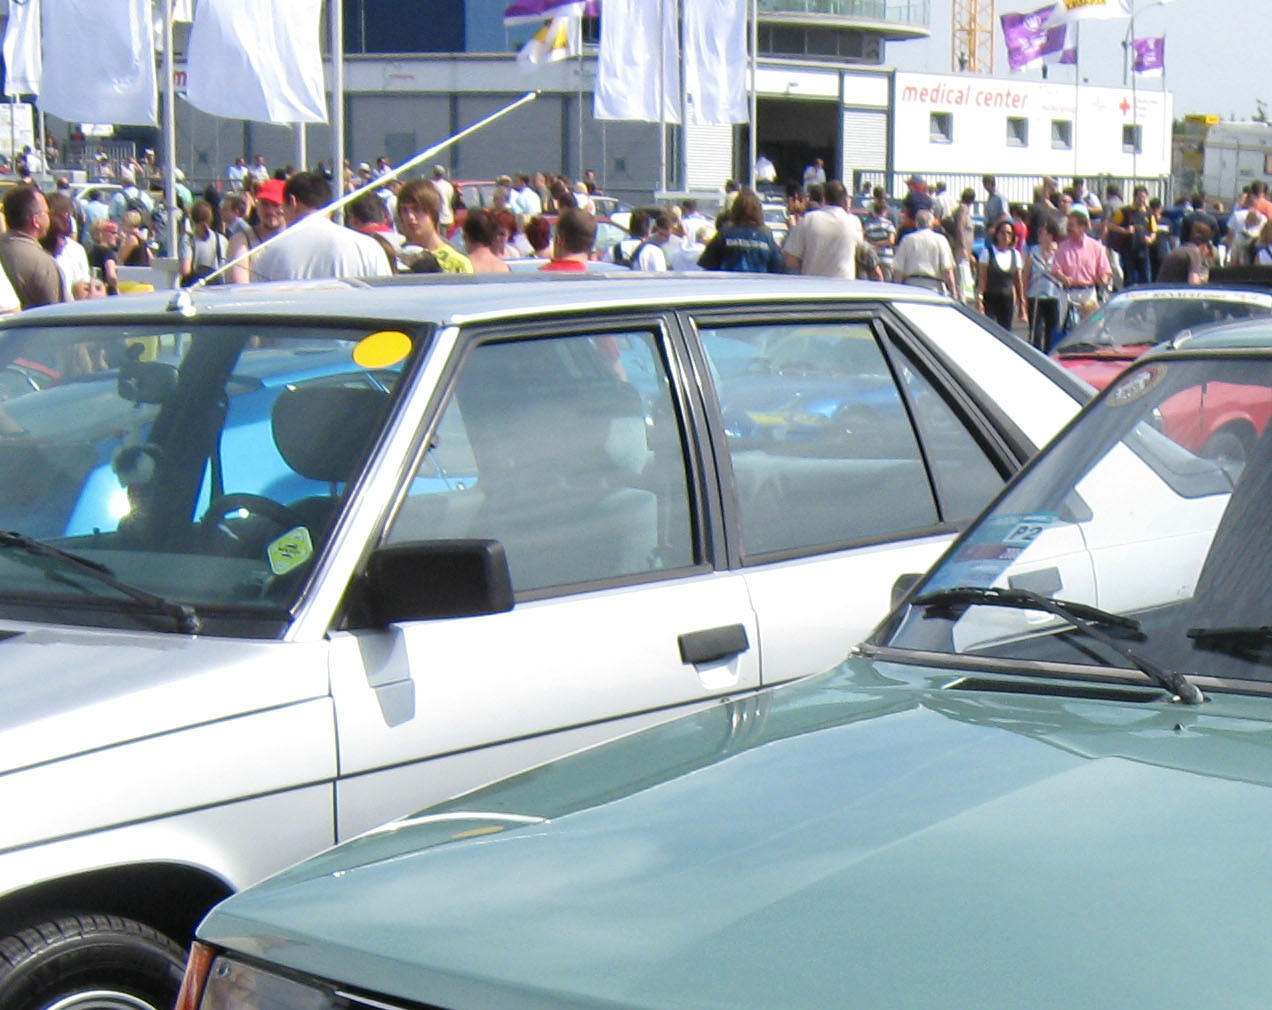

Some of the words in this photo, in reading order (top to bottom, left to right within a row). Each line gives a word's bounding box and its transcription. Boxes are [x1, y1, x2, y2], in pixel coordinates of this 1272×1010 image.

[902, 83, 970, 105] medical
[976, 89, 1028, 109] center
[1008, 525, 1043, 540] P2
